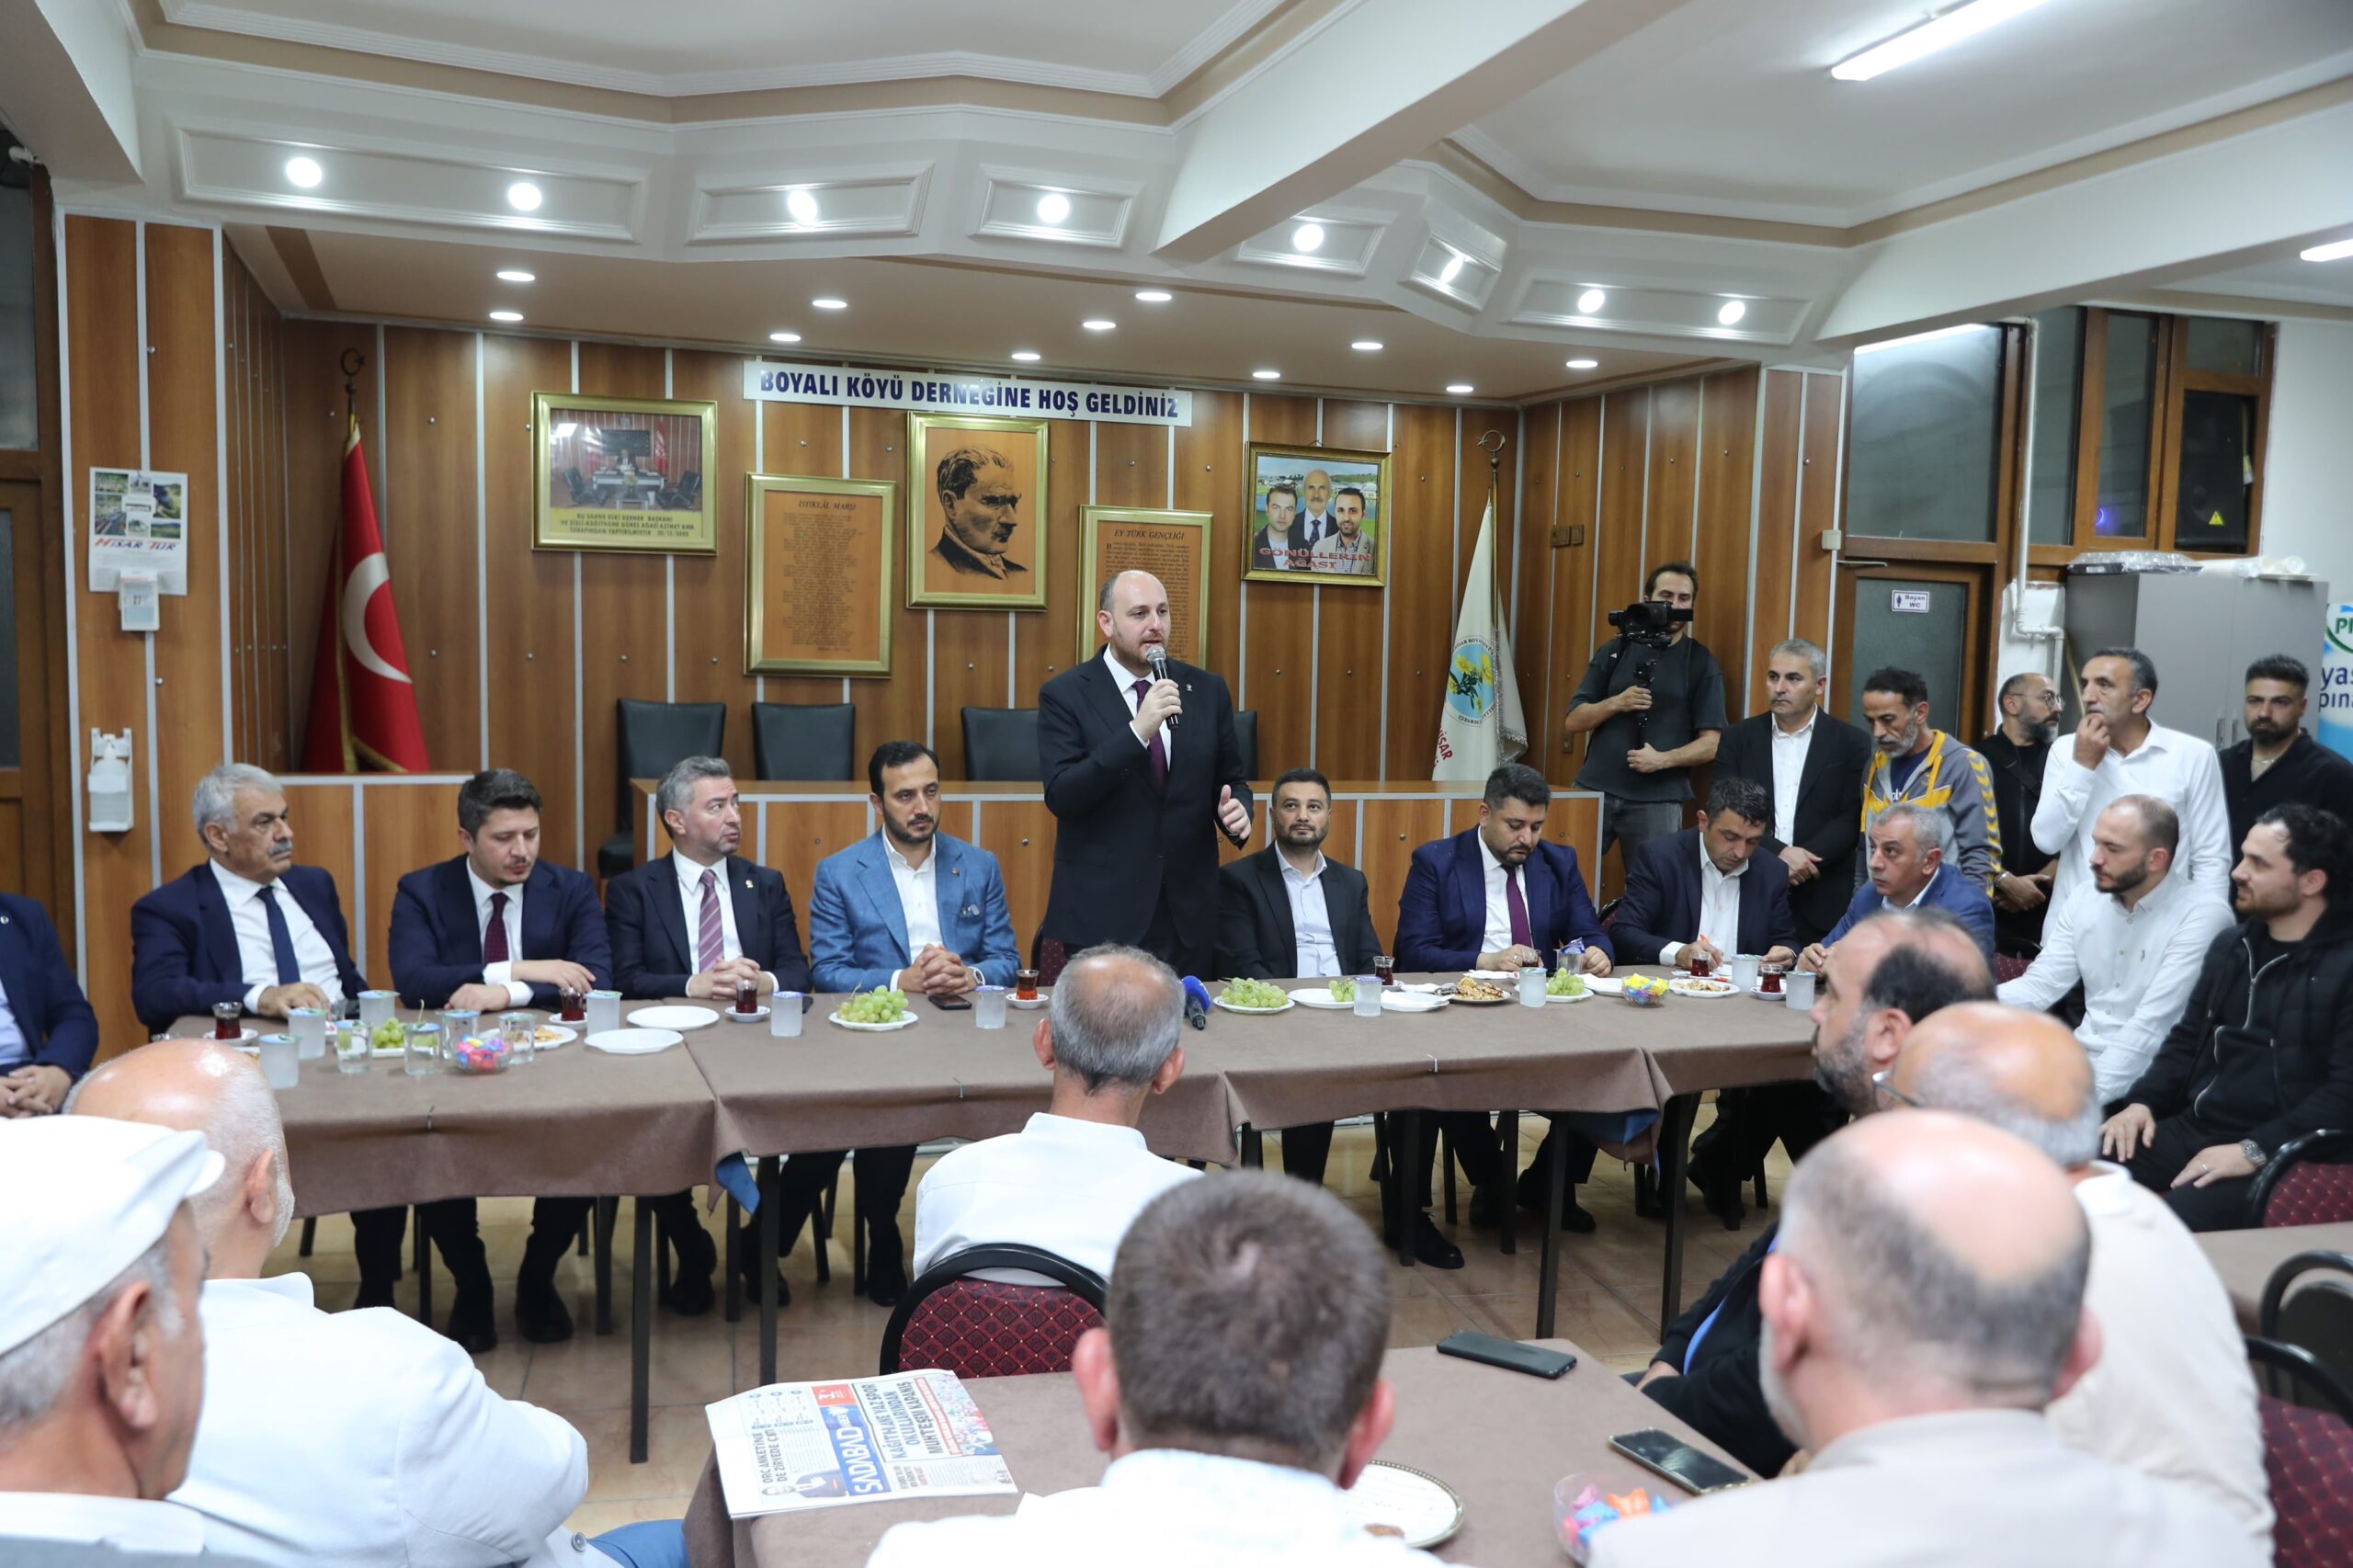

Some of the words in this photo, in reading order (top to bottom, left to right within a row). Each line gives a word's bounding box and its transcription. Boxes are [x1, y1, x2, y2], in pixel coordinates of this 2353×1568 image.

[760, 370, 838, 396] BOYALI
[847, 373, 904, 400] KÖYÜ
[912, 380, 1030, 409] DERNEĞİNE
[1039, 390, 1079, 417] HOŞ
[1086, 391, 1179, 418] GELDİNİZ
[1127, 529, 1147, 539] TÜRK
[1258, 547, 1371, 562] GÖNÜLLERİN
[1284, 559, 1337, 569] AĞASI
